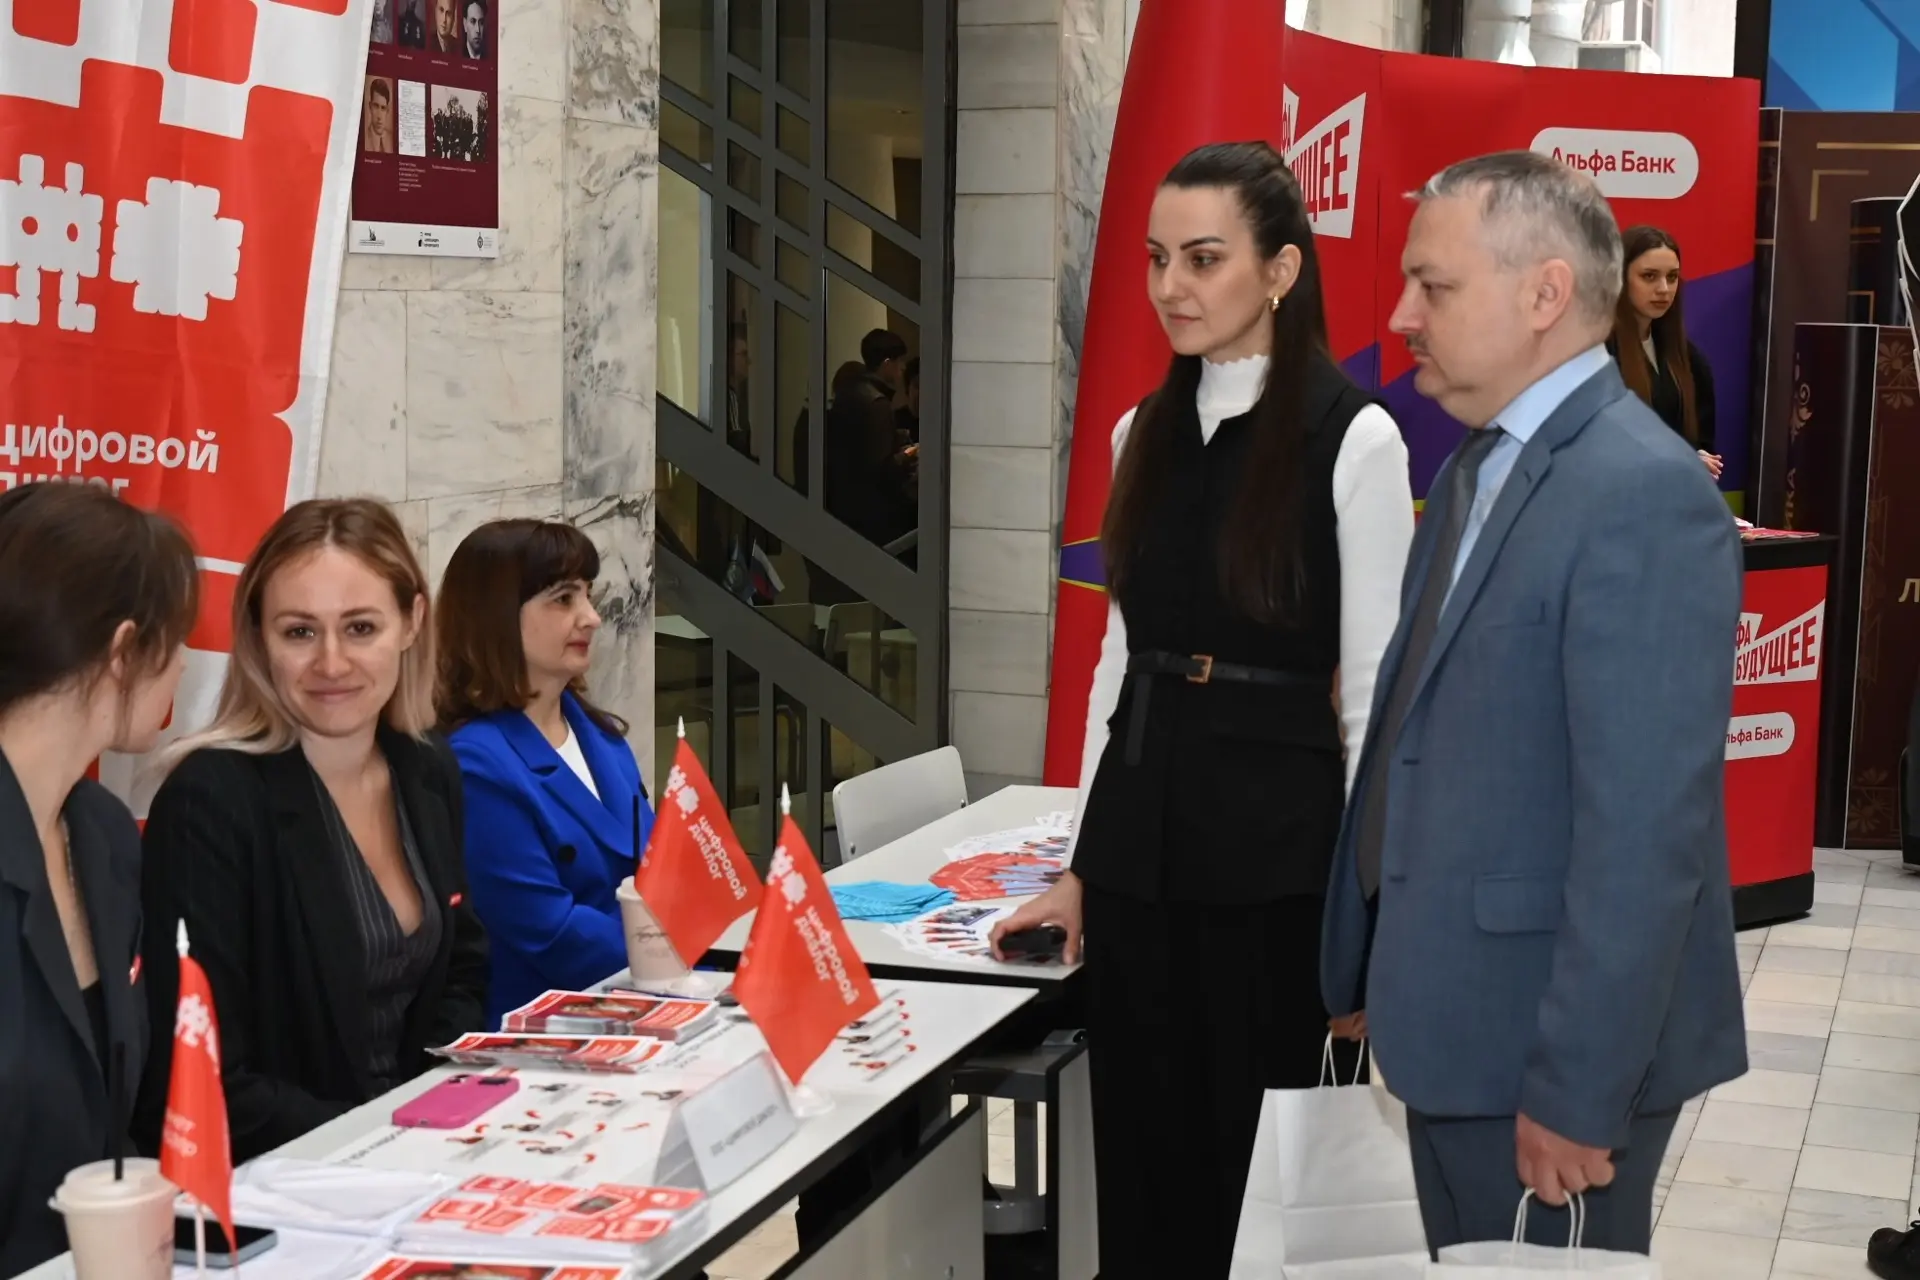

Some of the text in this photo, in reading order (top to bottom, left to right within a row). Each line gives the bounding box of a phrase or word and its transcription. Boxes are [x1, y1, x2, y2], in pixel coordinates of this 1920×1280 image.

[1552, 147, 1676, 177] Альфа Банк
[1736, 616, 1817, 681] БУДУЩЕЕ
[1755, 726, 1784, 741] Банк
[699, 815, 747, 900] цифровой
[806, 905, 860, 1005] цифровой
